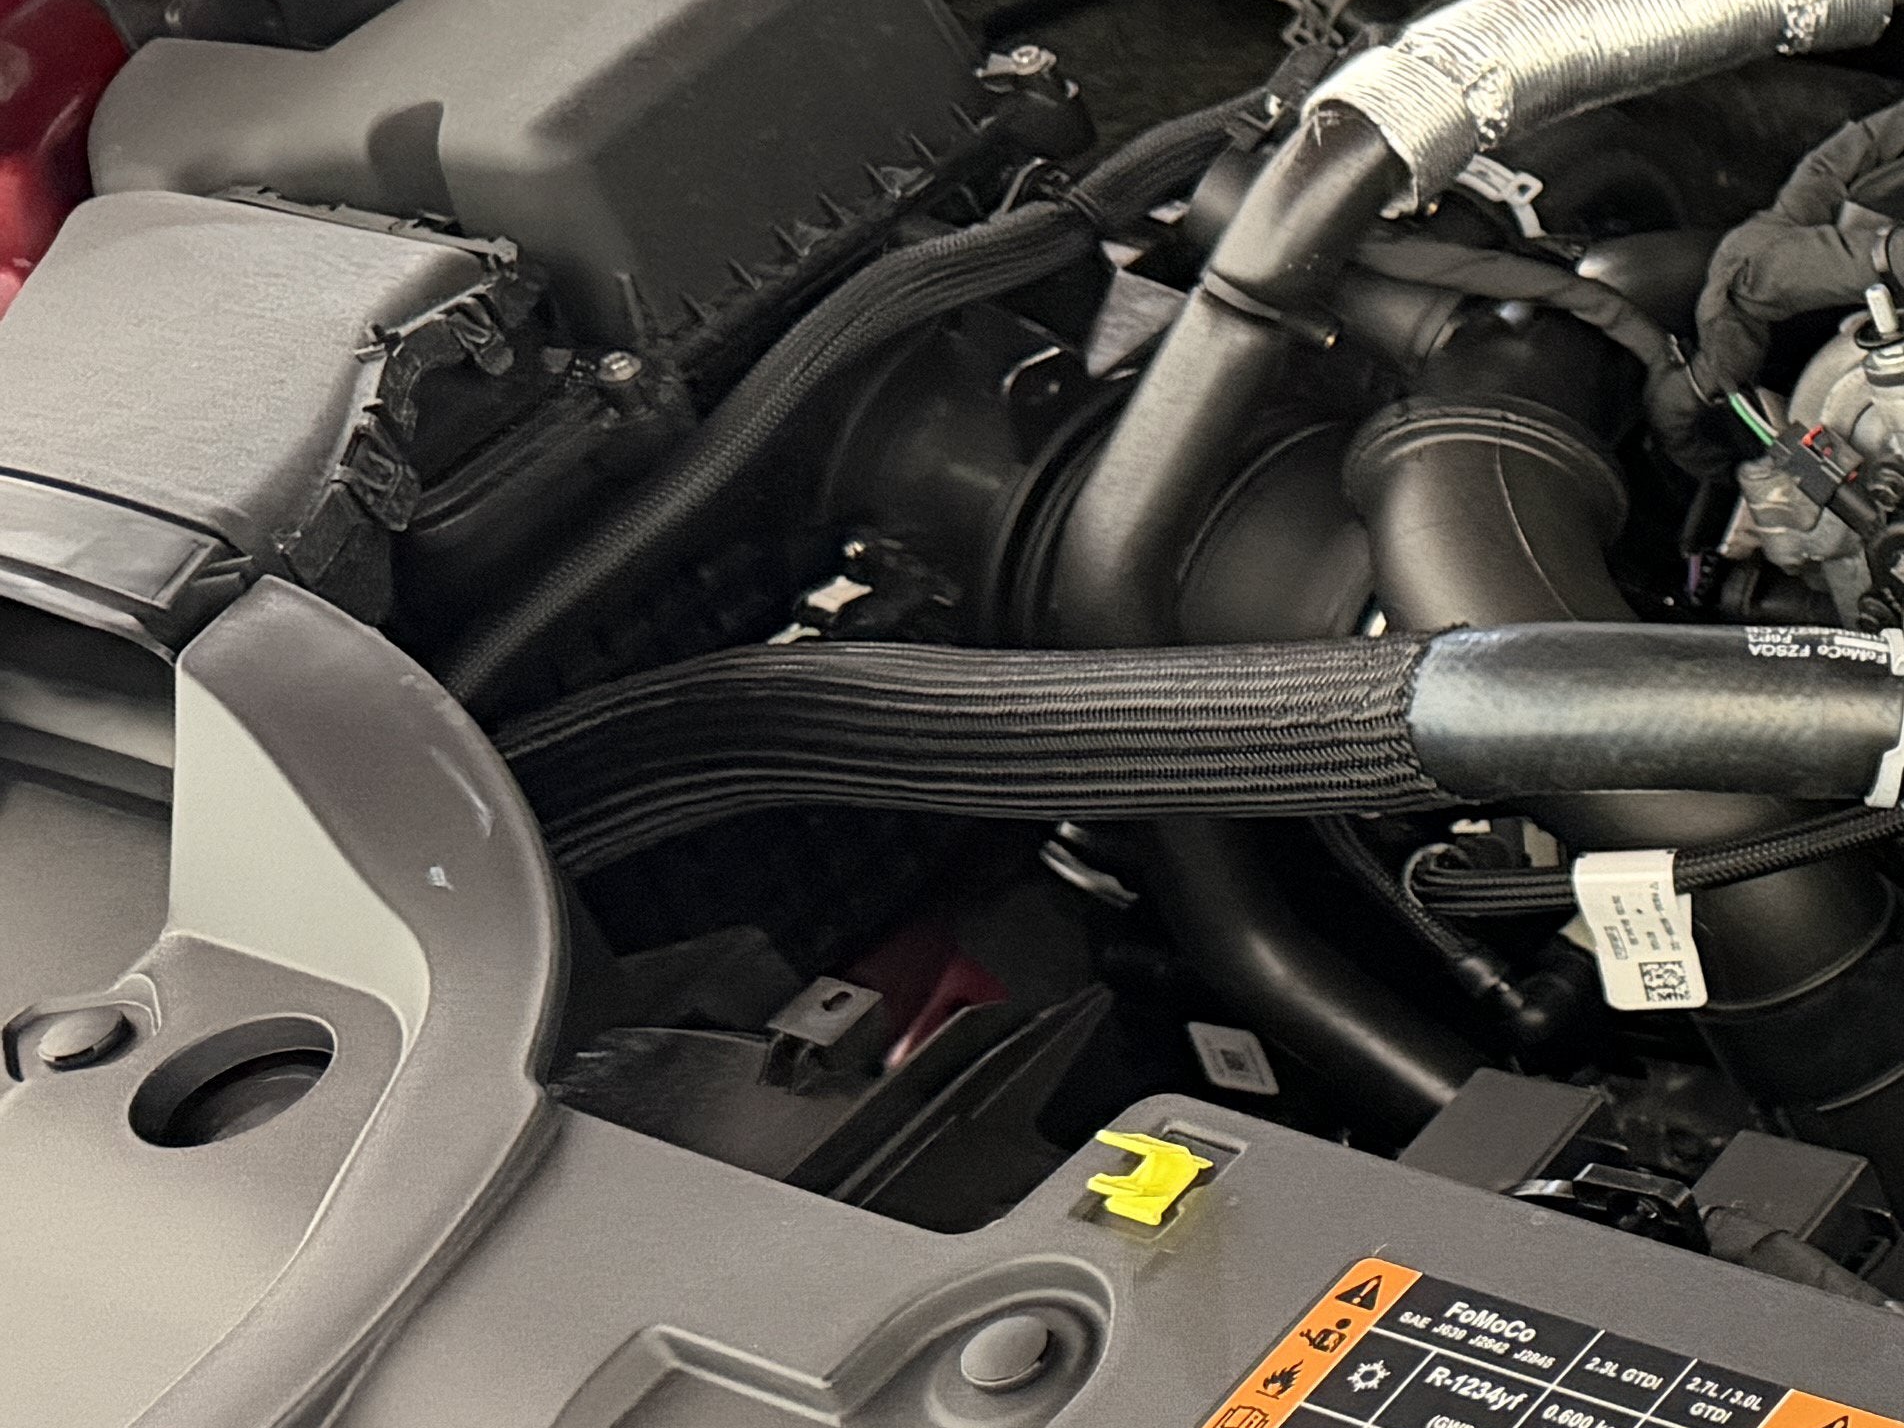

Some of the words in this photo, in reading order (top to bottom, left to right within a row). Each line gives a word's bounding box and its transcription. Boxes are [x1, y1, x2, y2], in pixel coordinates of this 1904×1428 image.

[1817, 644, 1888, 665] FoMoCo
[1399, 1311, 1432, 1329] SAE
[1444, 1301, 1537, 1343] FoMoCo
[1424, 1366, 1529, 1411] R-1234yf
[1584, 1356, 1618, 1378] 2.3L
[1620, 1369, 1664, 1391] GTDI
[1685, 1376, 1720, 1400] 2.7L
[1730, 1390, 1764, 1412] 3.0L
[1689, 1402, 1733, 1425] GTDI
